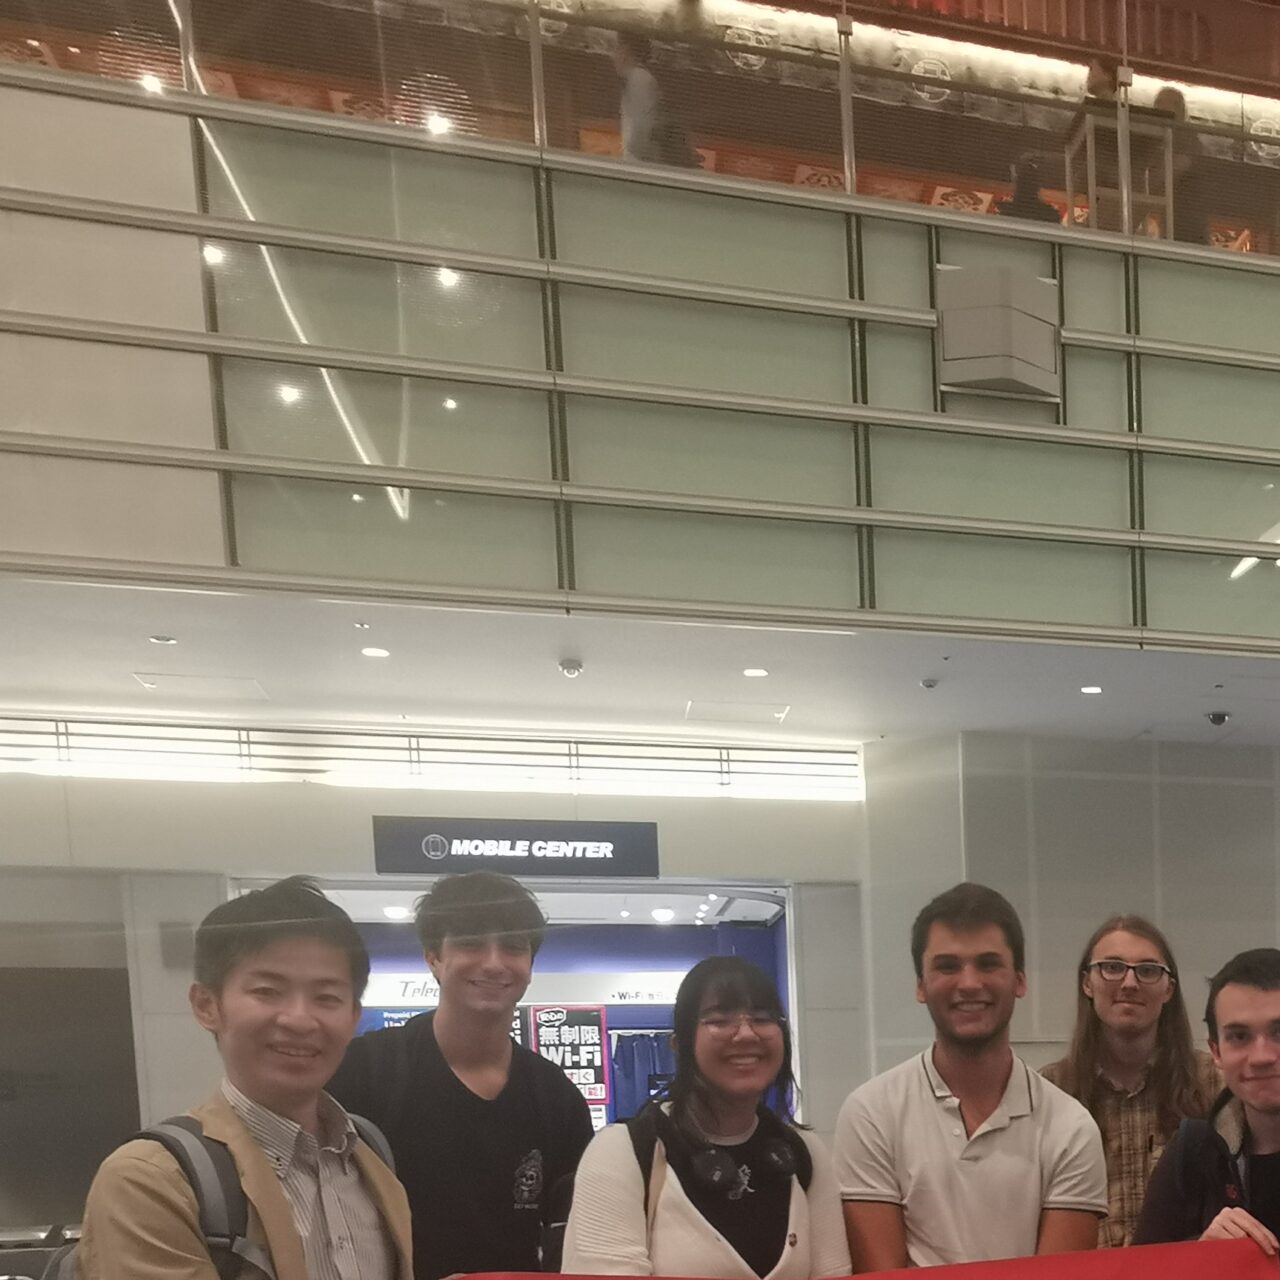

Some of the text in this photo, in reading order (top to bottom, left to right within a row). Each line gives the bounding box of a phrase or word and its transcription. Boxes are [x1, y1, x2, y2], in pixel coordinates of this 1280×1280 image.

[450, 839, 615, 858] MOBILE CENTER
[538, 1025, 600, 1045] 無制限
[539, 1046, 602, 1067] Wi-Fi
